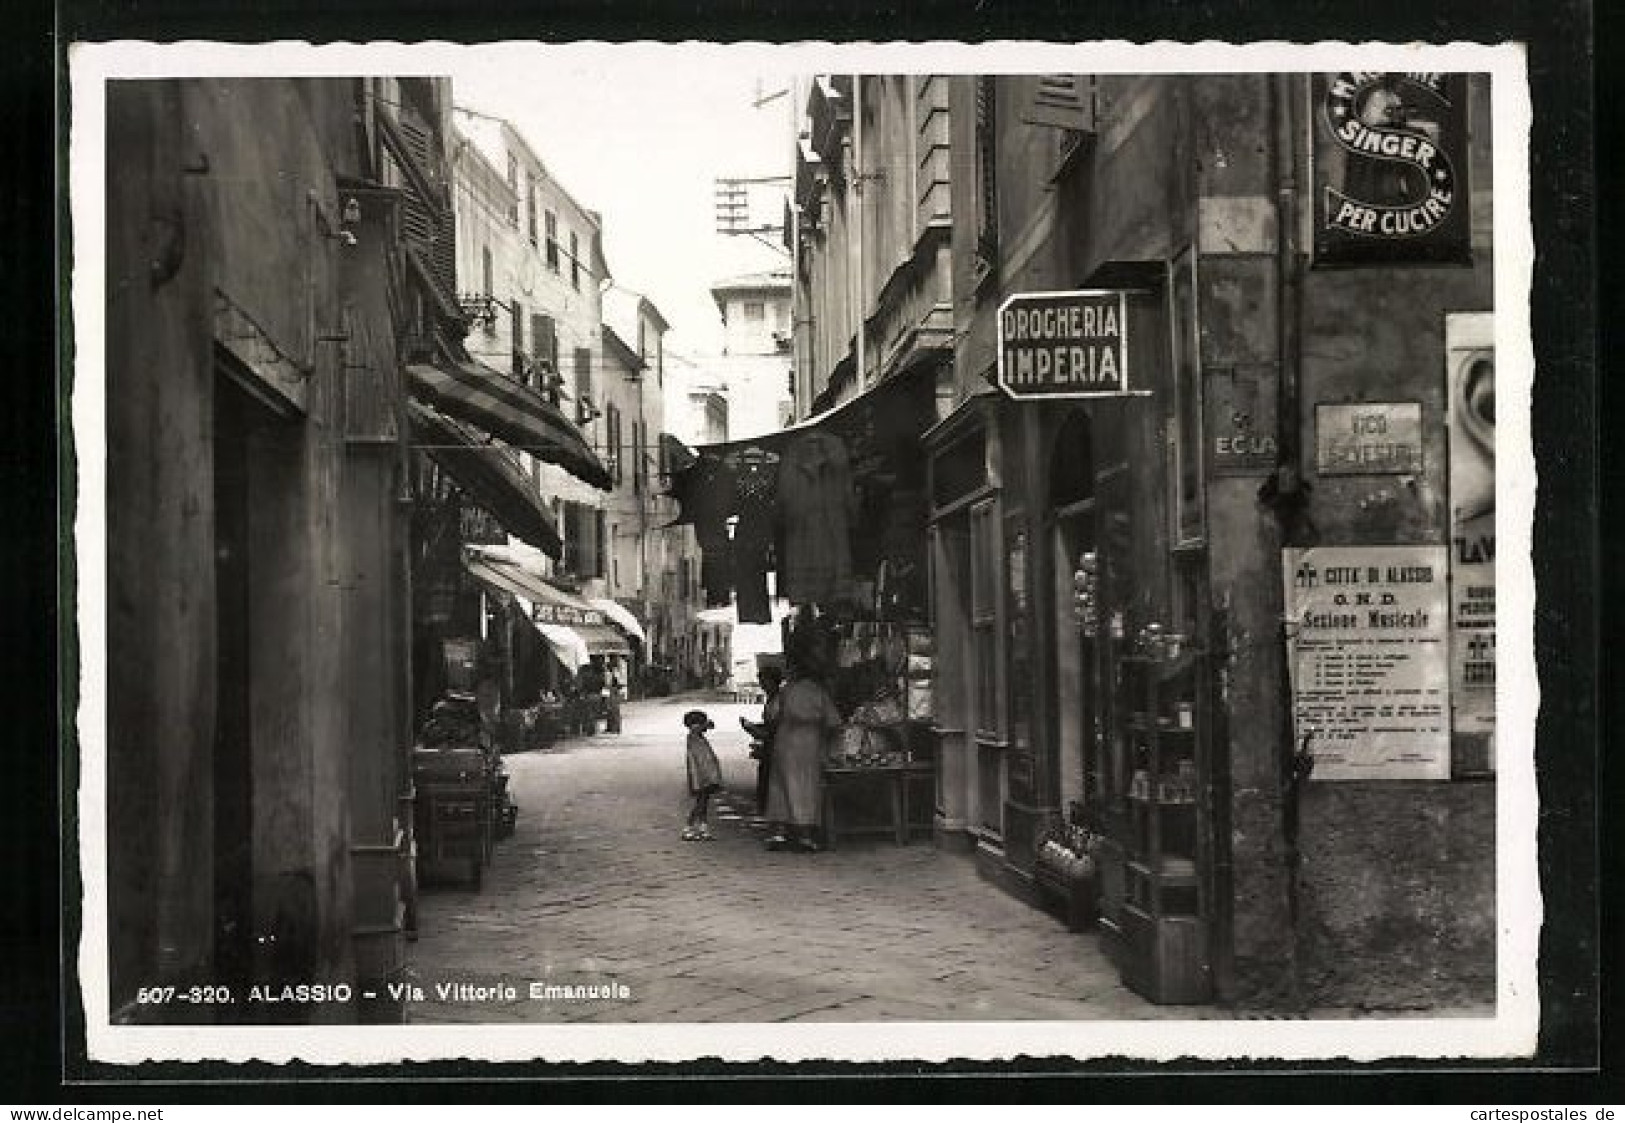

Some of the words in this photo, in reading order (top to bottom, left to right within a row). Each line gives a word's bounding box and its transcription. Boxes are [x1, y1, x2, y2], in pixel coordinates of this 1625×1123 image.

[1338, 119, 1437, 168] SINGER
[1336, 201, 1377, 232] PER
[1380, 187, 1452, 233] CUCIRE
[1004, 305, 1119, 342] DROGHERIA
[1006, 345, 1119, 384] IMPERIA
[1303, 610, 1357, 629] Sezione
[1367, 607, 1429, 629] Musicale
